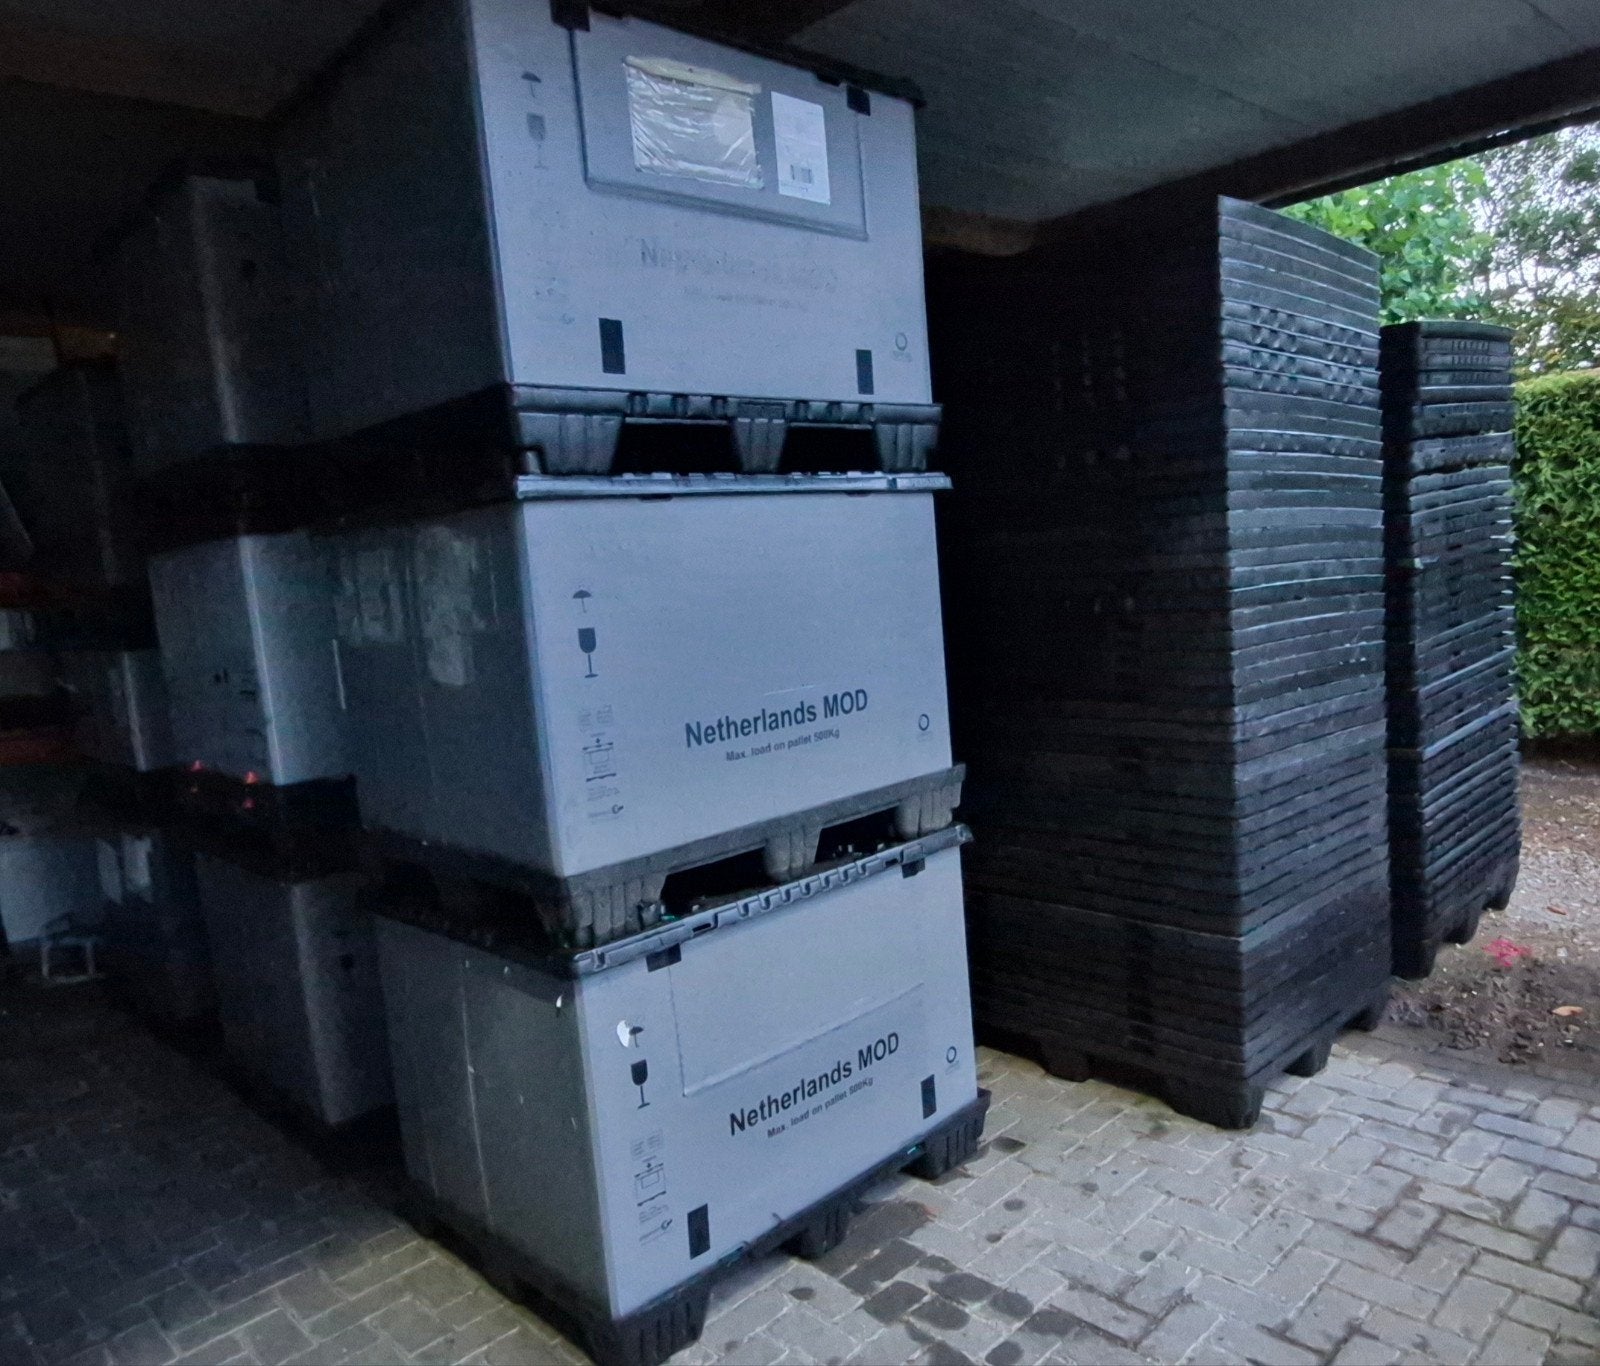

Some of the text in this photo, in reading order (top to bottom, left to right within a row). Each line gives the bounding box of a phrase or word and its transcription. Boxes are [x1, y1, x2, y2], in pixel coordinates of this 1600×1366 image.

[685, 688, 868, 748] Netherlands MOD
[751, 743, 771, 757] load
[773, 742, 786, 752] on
[787, 735, 812, 750] pallet
[729, 1032, 899, 1136] Netherlands MOD
[790, 1108, 810, 1127] load
[812, 1104, 823, 1116] on
[825, 1091, 848, 1111] pallet
